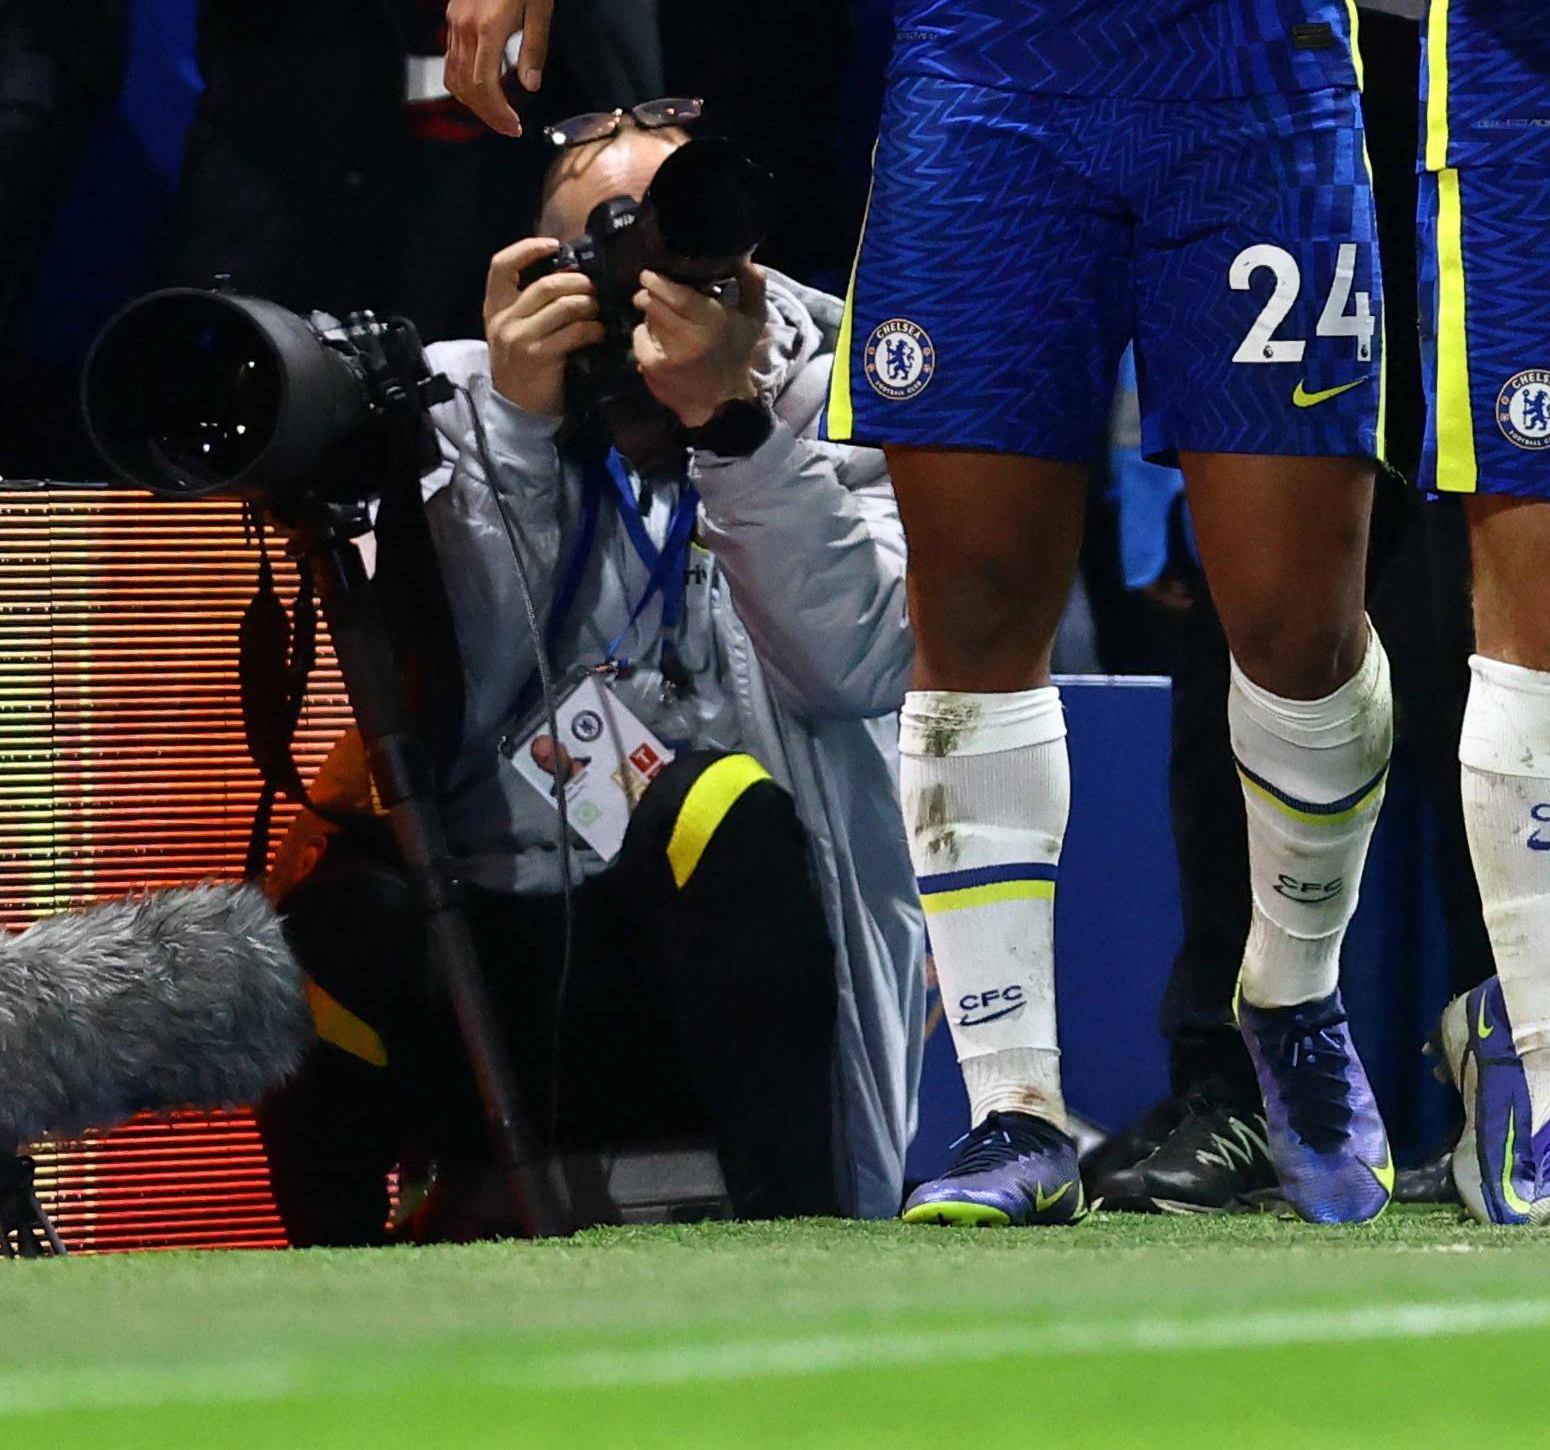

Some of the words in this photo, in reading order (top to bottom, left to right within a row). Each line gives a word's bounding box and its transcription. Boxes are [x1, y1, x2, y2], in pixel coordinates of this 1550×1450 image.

[1229, 243, 1376, 363] 24
[876, 322, 920, 338] CHELSEA
[1278, 873, 1343, 893] CFC
[959, 984, 1023, 1011] CFC
